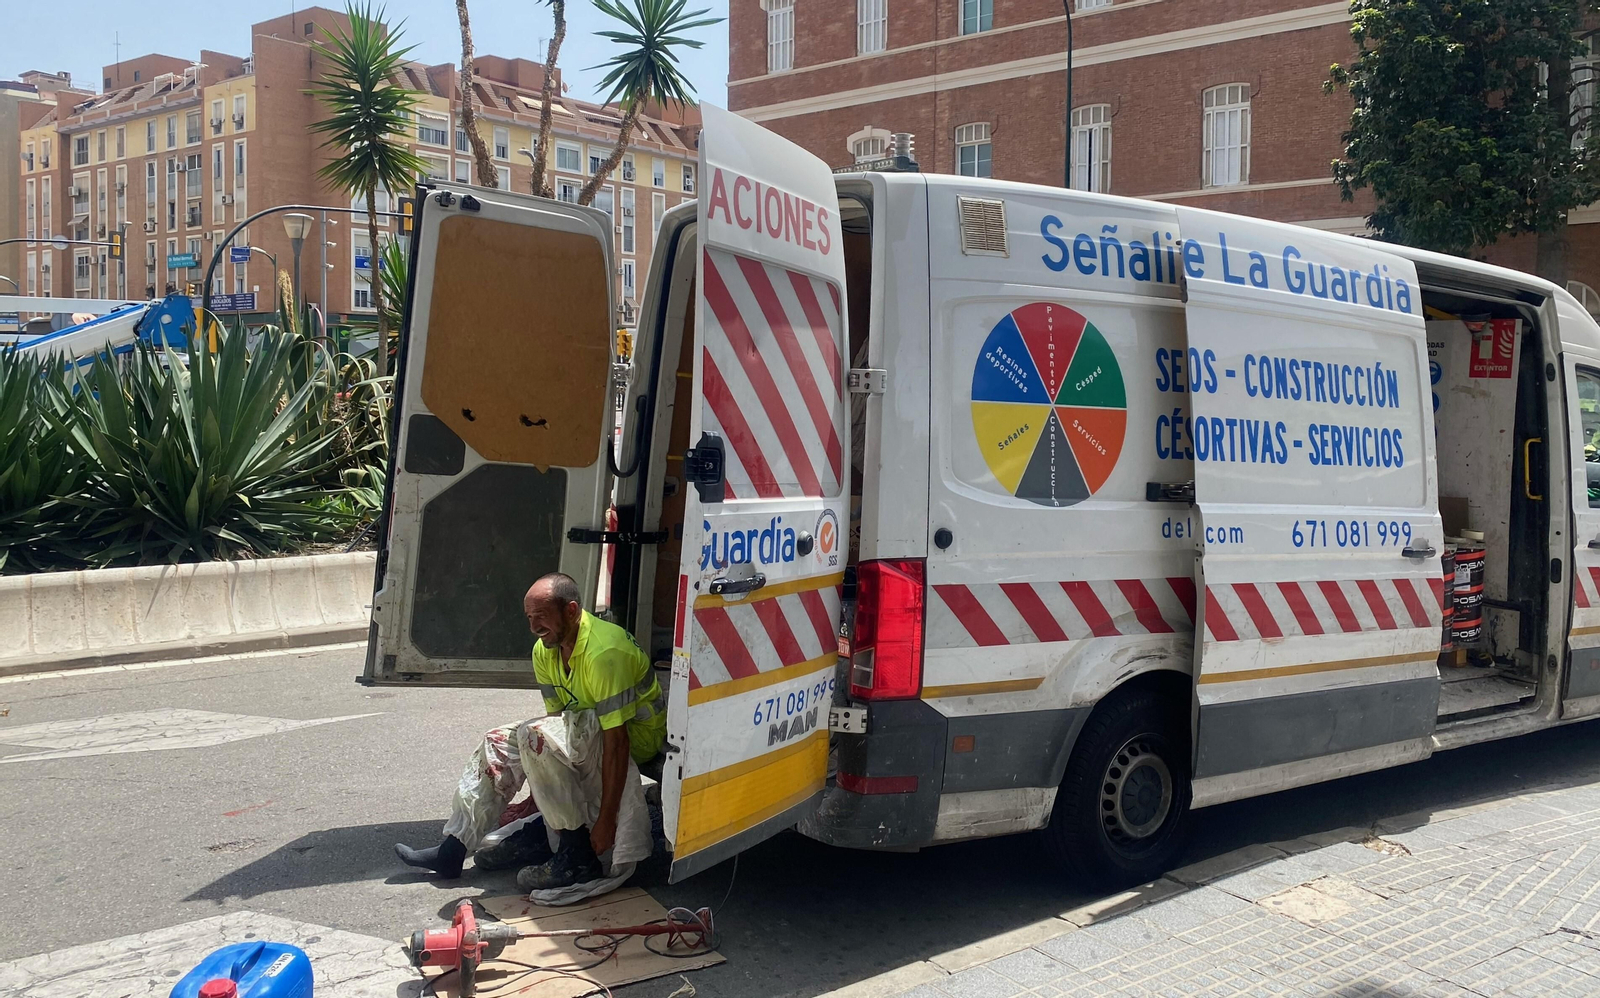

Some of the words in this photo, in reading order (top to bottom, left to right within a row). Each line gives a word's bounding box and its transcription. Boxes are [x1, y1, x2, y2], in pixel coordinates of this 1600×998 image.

[708, 168, 831, 255] ACIONES
[1219, 232, 1268, 290] La
[1283, 244, 1413, 314] Guardia
[996, 346, 1028, 379] Resinas
[1046, 305, 1056, 395] Pavimentos
[985, 352, 1028, 393] deportivas
[1075, 366, 1102, 391] Césped
[1156, 347, 1189, 393] SE
[1244, 353, 1400, 408] CONSTRUCCIÓN
[998, 423, 1030, 451] Señales
[1072, 419, 1107, 456] Servicios
[1195, 416, 1288, 465] ORTIVAS
[1308, 424, 1404, 468] SERVICIOS
[1205, 526, 1244, 544] com
[1292, 520, 1327, 547] 671
[1336, 520, 1369, 547] 081
[1378, 520, 1413, 547] 999
[828, 555, 838, 566] SGS
[753, 697, 781, 726] 671
[786, 688, 810, 716] 081
[767, 706, 818, 747] MAN
